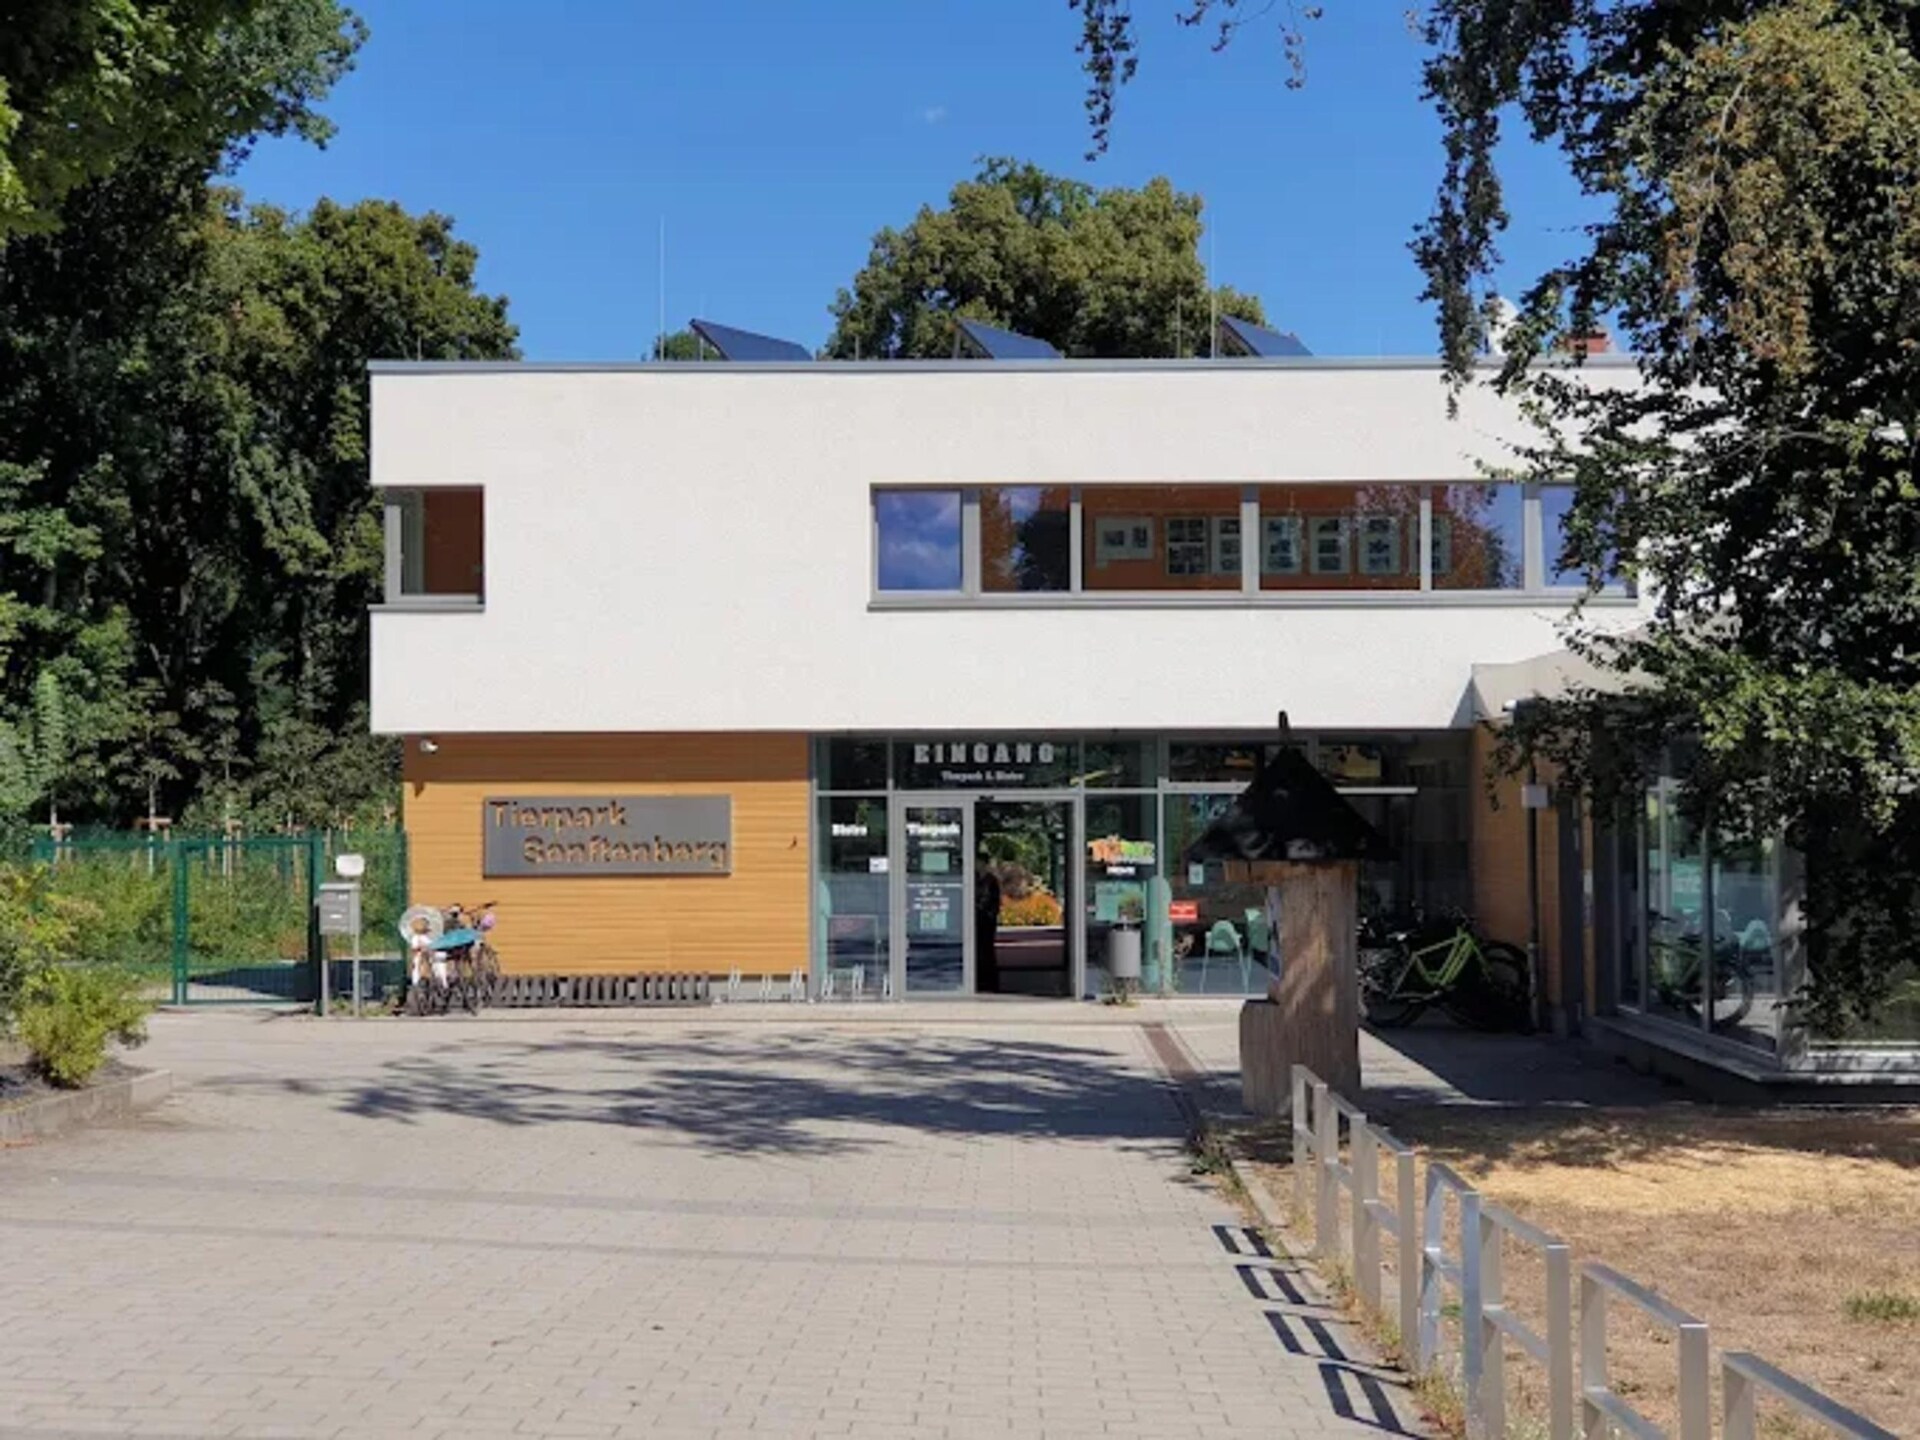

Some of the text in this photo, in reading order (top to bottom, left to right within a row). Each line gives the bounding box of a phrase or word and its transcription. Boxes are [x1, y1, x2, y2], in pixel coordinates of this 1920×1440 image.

[914, 742, 1055, 764] EINGANG
[489, 800, 626, 833] Tierpark
[523, 835, 727, 869] Senftenberg
